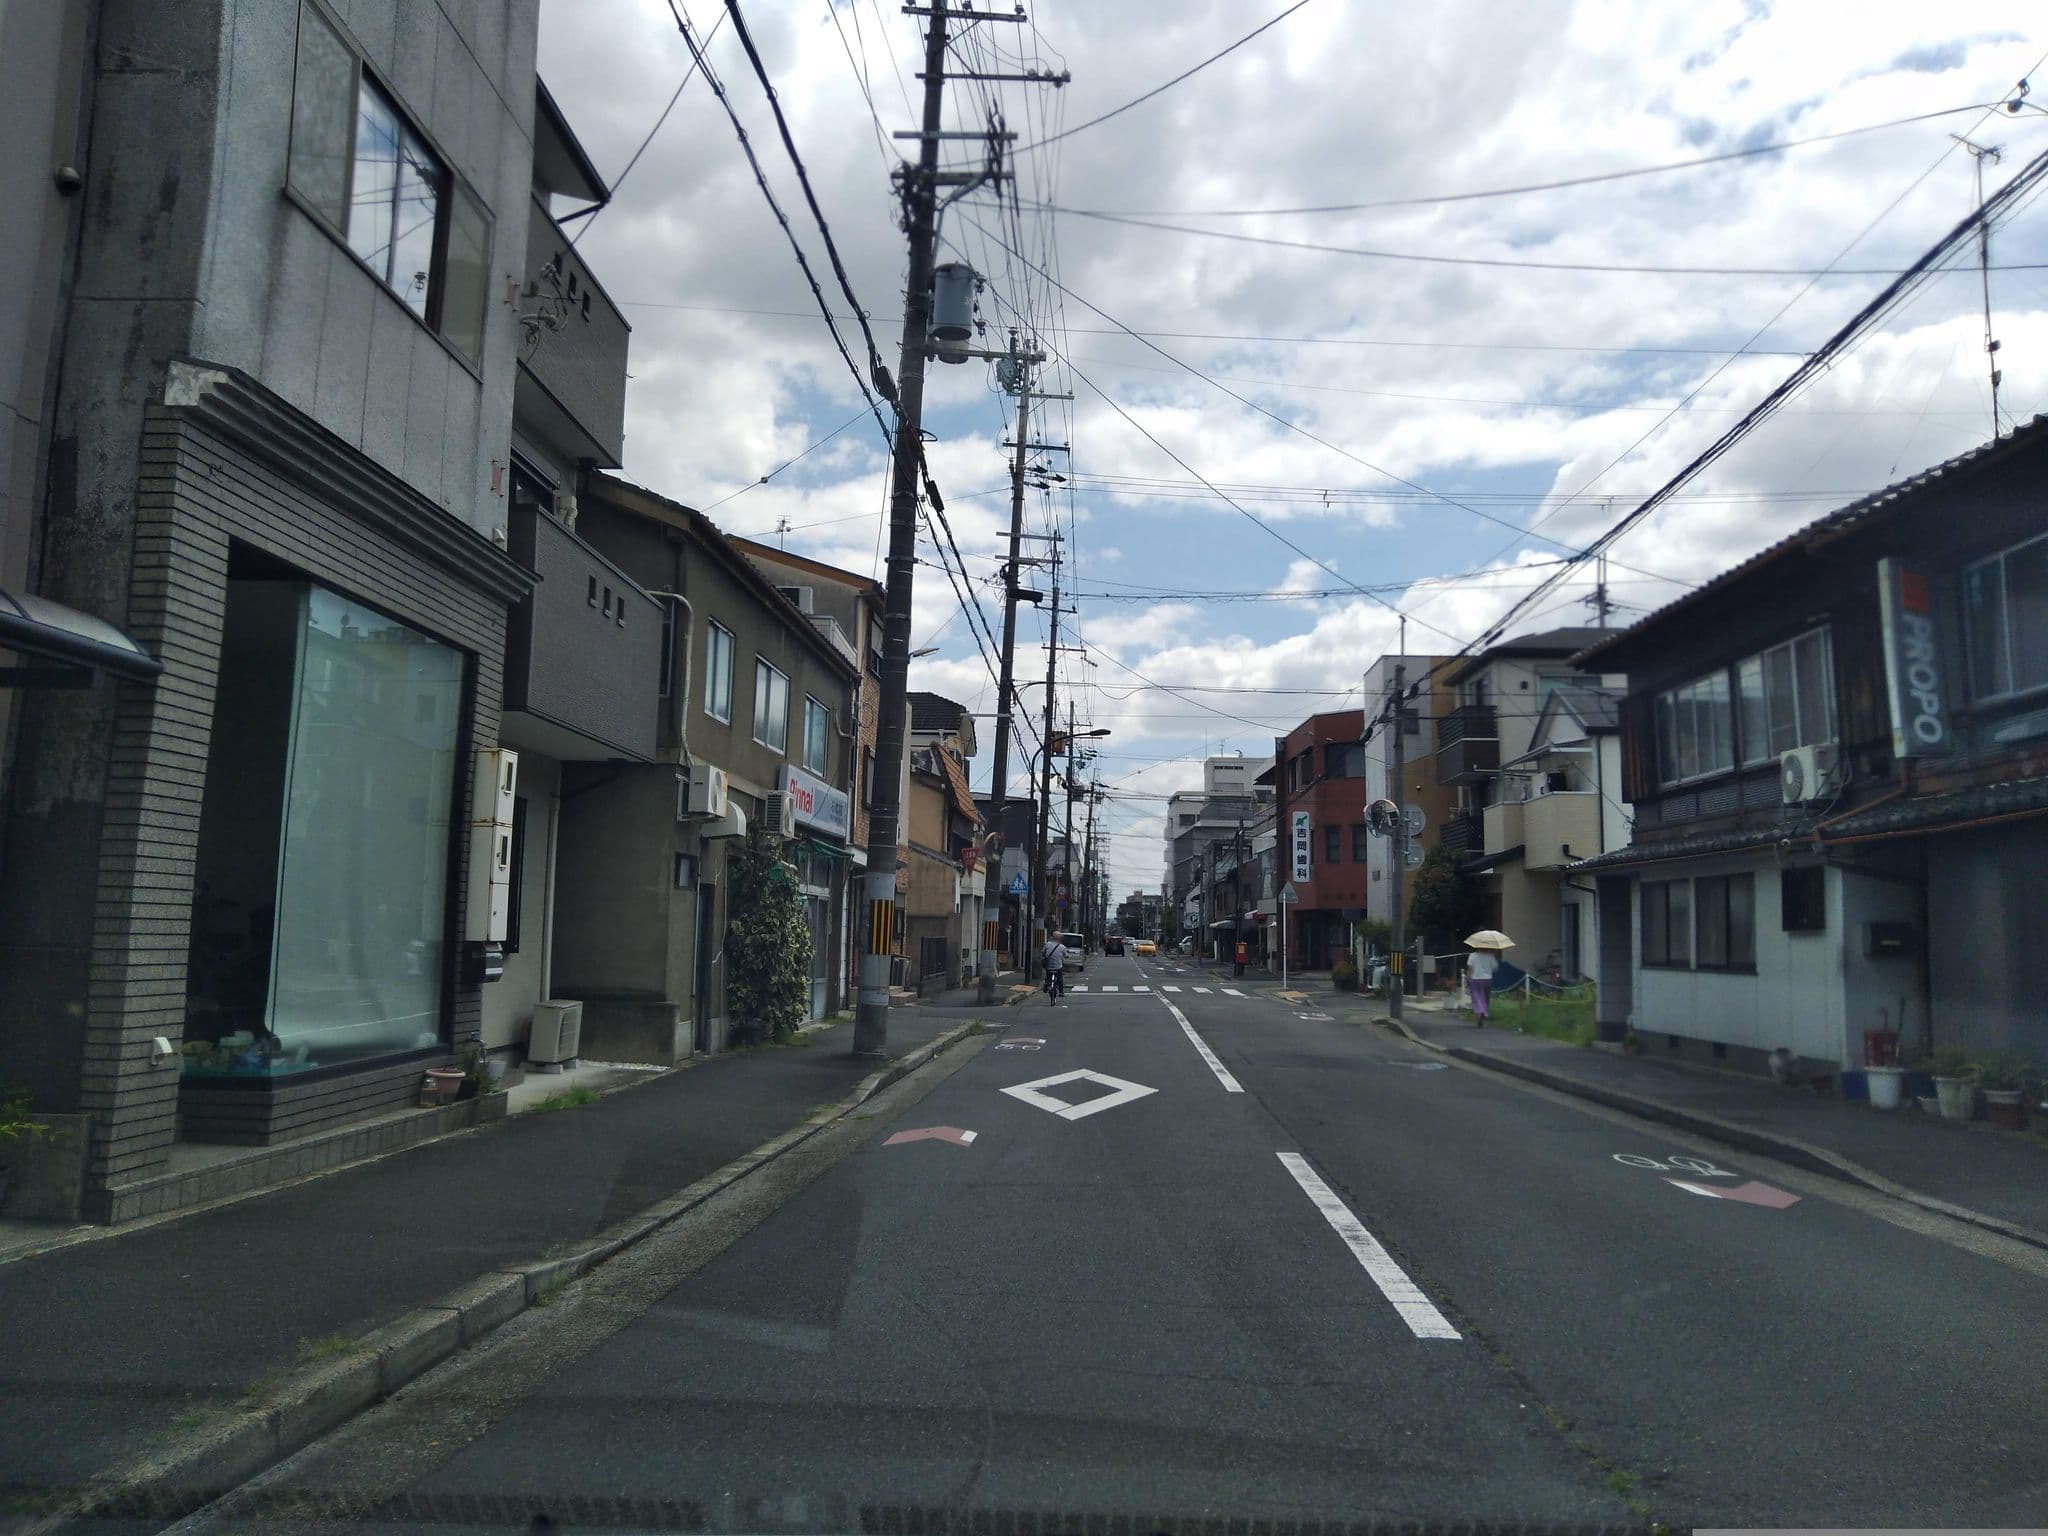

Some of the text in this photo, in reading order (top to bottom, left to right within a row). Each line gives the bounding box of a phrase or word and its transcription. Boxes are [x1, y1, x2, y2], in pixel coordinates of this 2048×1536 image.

[1903, 614, 1943, 743] PROPO
[1296, 828, 1308, 879] 吉岡歯科
